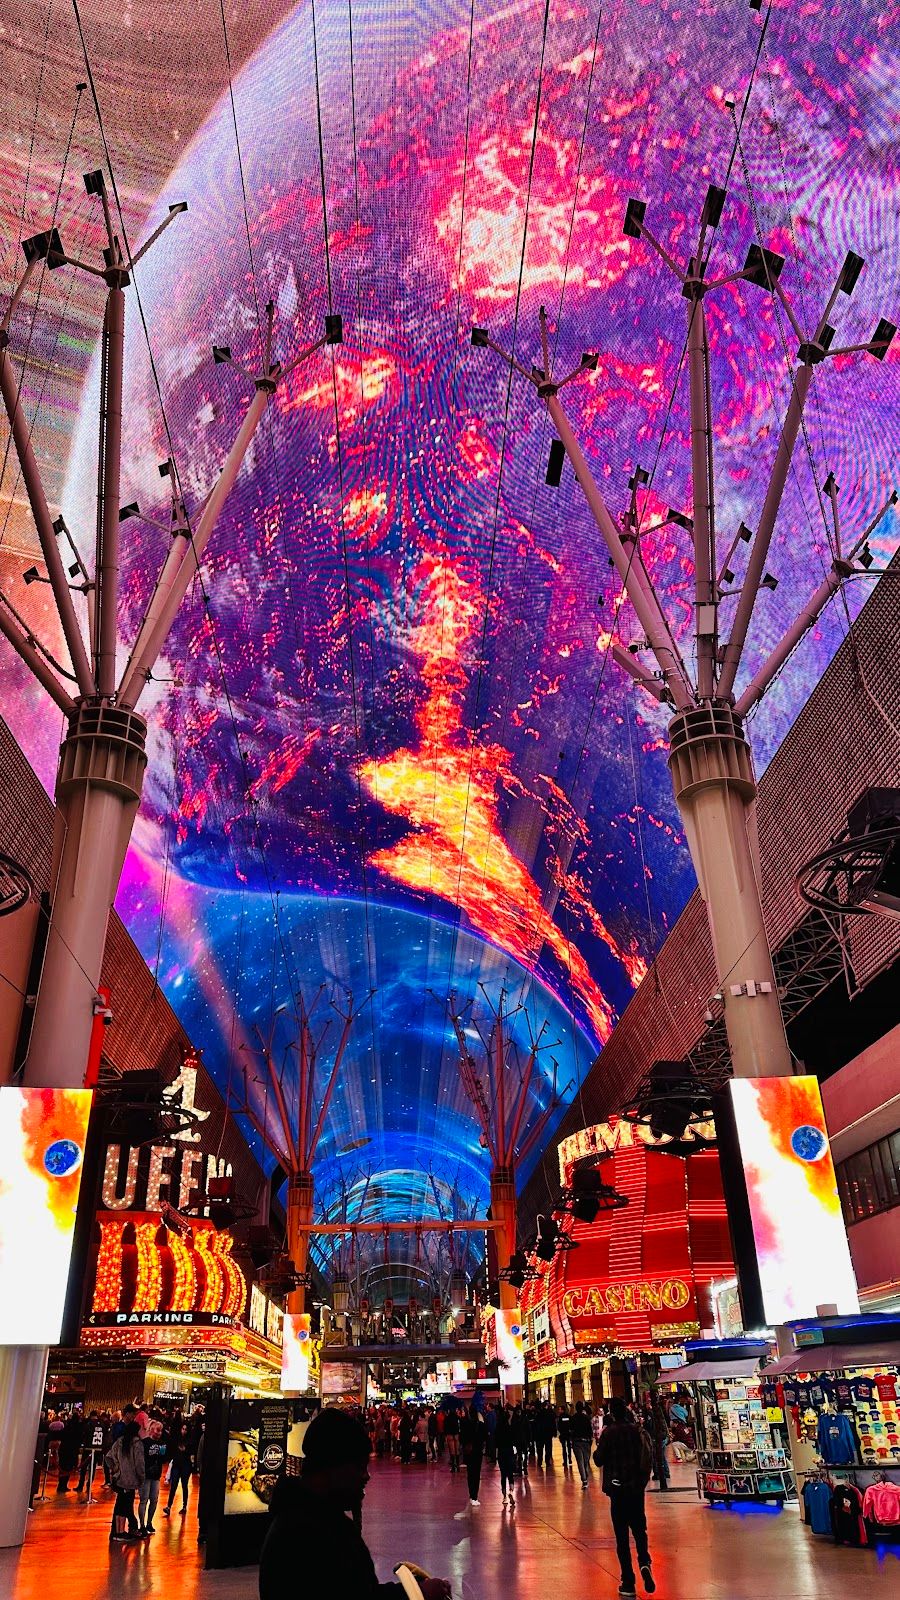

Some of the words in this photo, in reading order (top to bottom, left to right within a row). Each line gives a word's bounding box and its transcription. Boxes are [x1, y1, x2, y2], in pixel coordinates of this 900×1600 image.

[562, 1278, 690, 1318] CASINO
[117, 1313, 193, 1323] PARKING
[92, 1431, 103, 1446] 29
